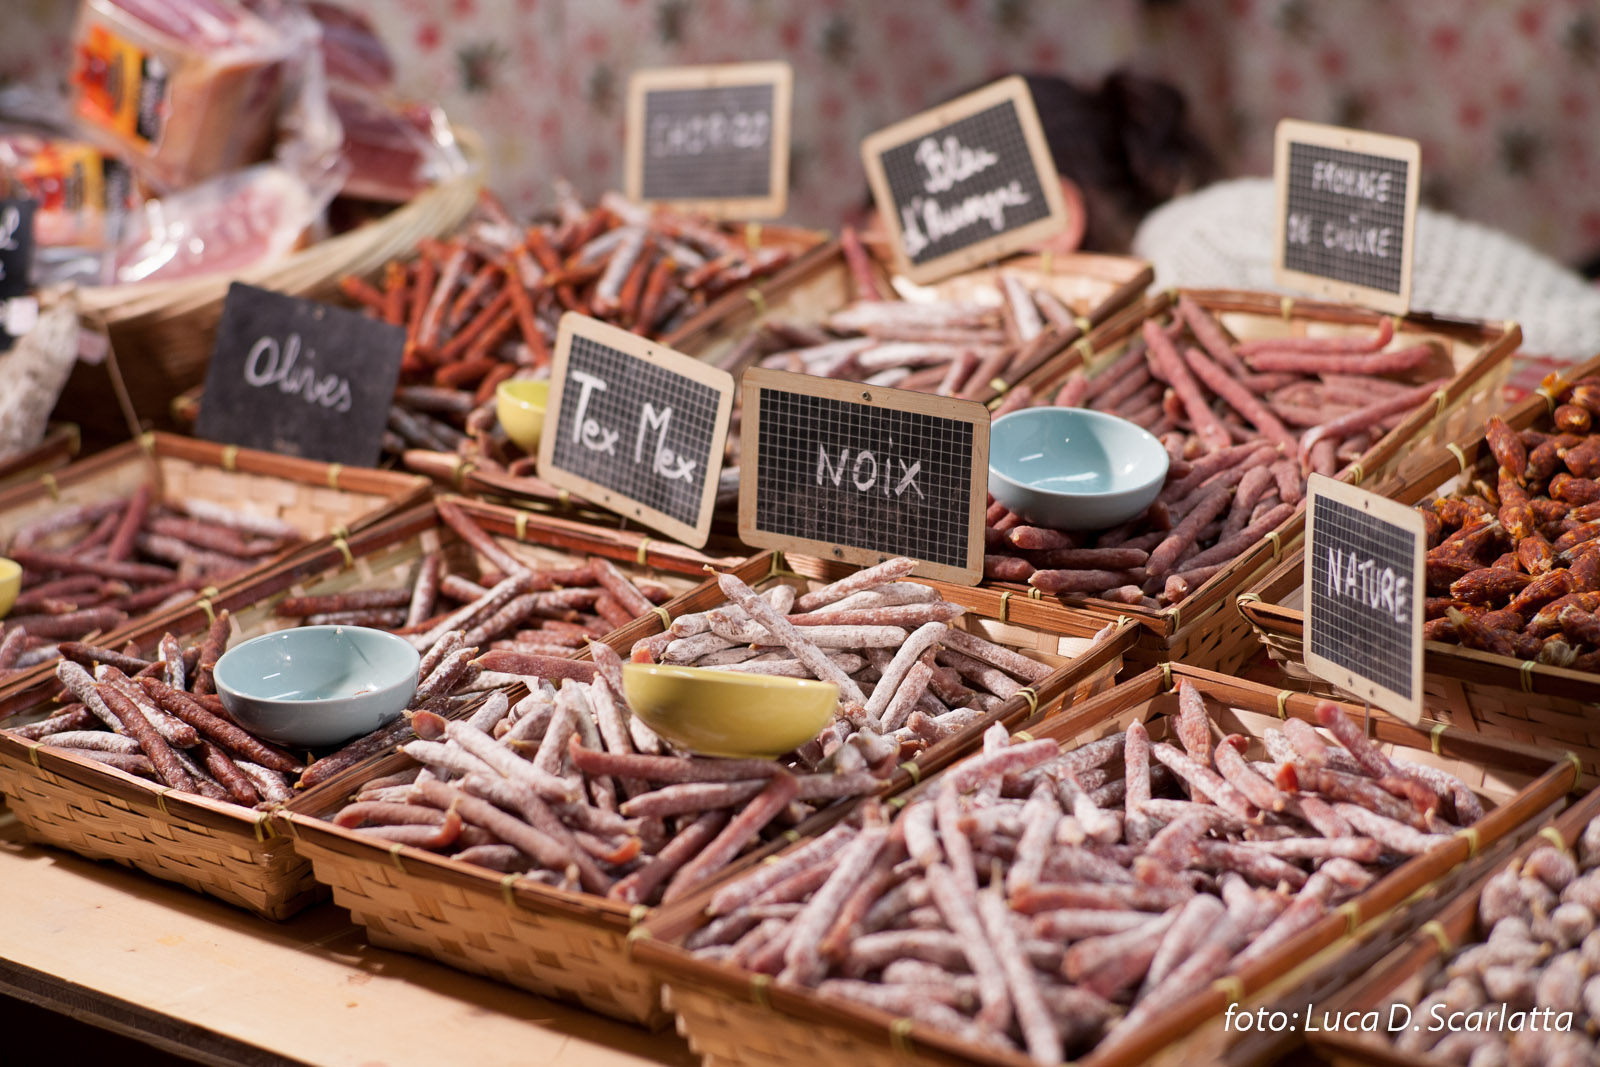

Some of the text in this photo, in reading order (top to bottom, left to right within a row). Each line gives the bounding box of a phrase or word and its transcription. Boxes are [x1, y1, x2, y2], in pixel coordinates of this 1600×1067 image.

[244, 333, 352, 412] Olives
[571, 369, 697, 483] Tex Mex
[1327, 546, 1407, 623] NATURE
